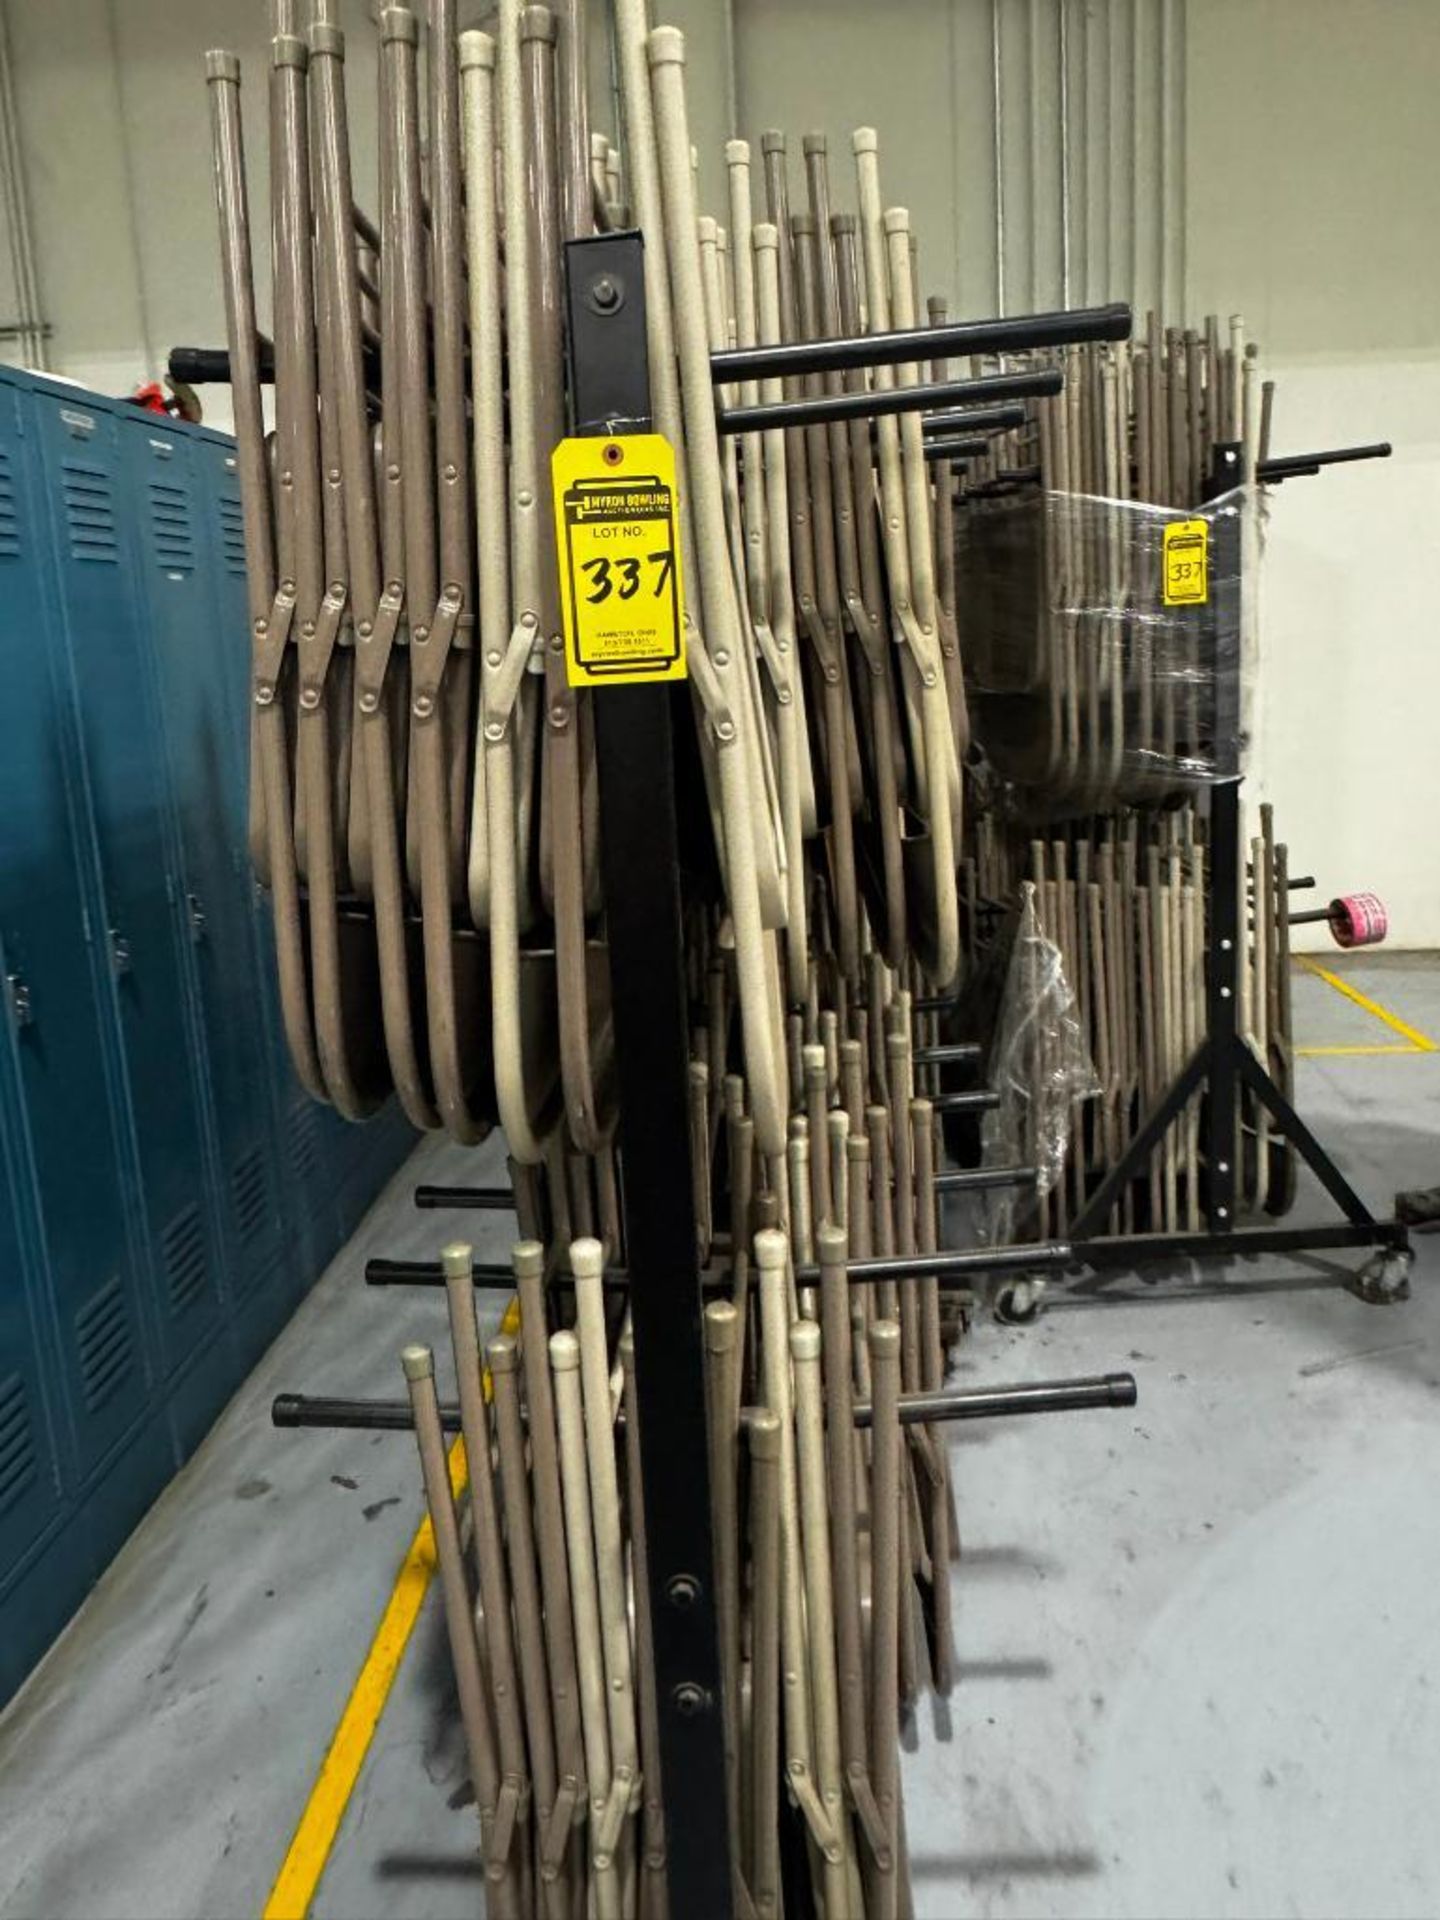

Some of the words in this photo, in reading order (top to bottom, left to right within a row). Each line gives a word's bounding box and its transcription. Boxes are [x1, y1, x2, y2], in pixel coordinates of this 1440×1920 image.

[626, 494, 669, 506] BOWLING
[593, 527, 618, 538] LOT
[623, 526, 646, 537] NO.
[581, 550, 674, 604] 337
[1170, 562, 1201, 581] 337
